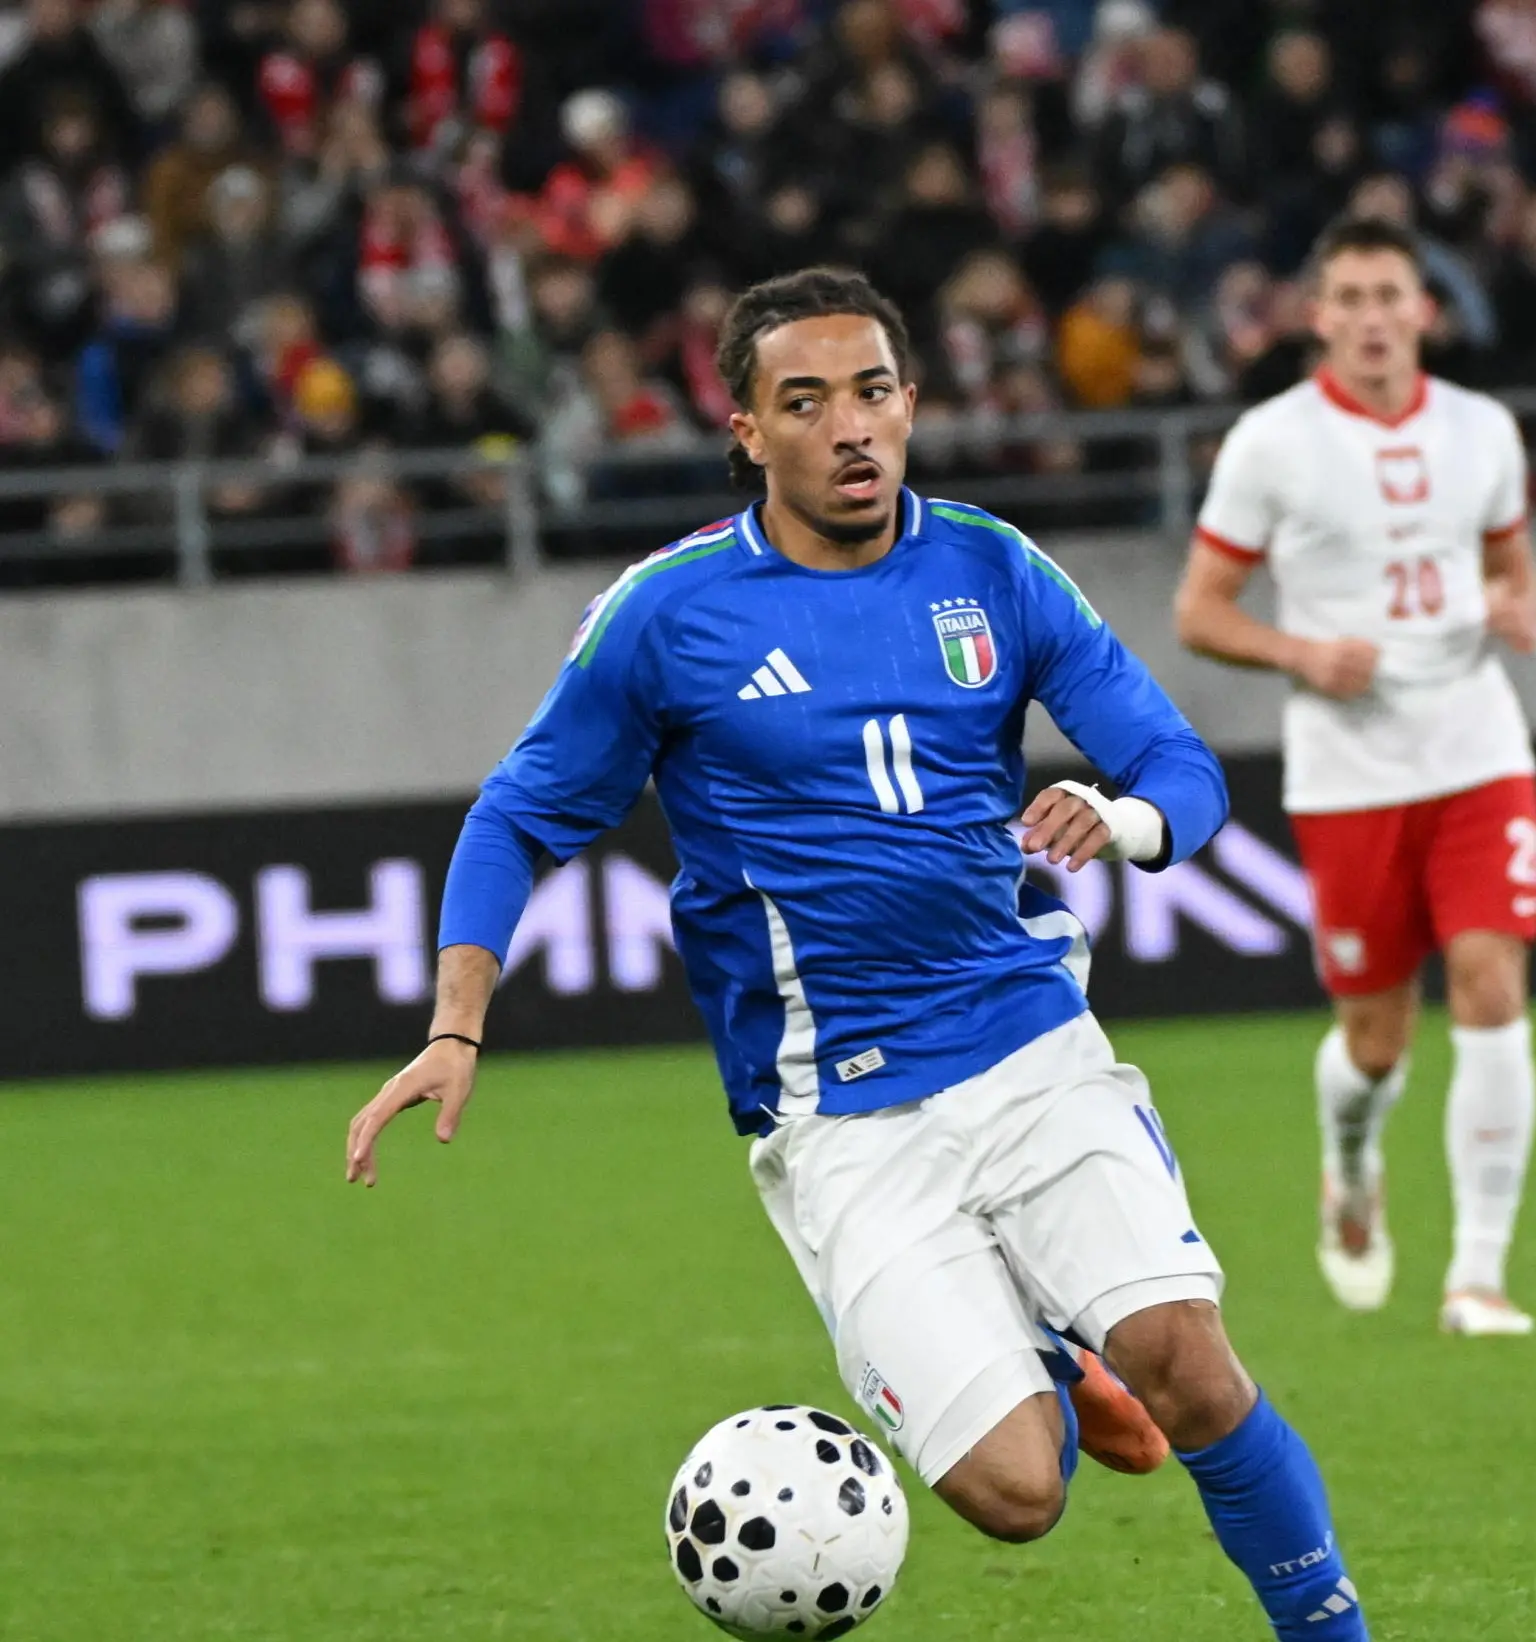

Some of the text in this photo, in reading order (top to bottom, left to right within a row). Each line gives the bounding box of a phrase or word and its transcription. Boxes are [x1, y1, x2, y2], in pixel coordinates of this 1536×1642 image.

[1382, 555, 1444, 622] 20
[938, 613, 985, 634] ITALIA
[864, 713, 924, 815] 11
